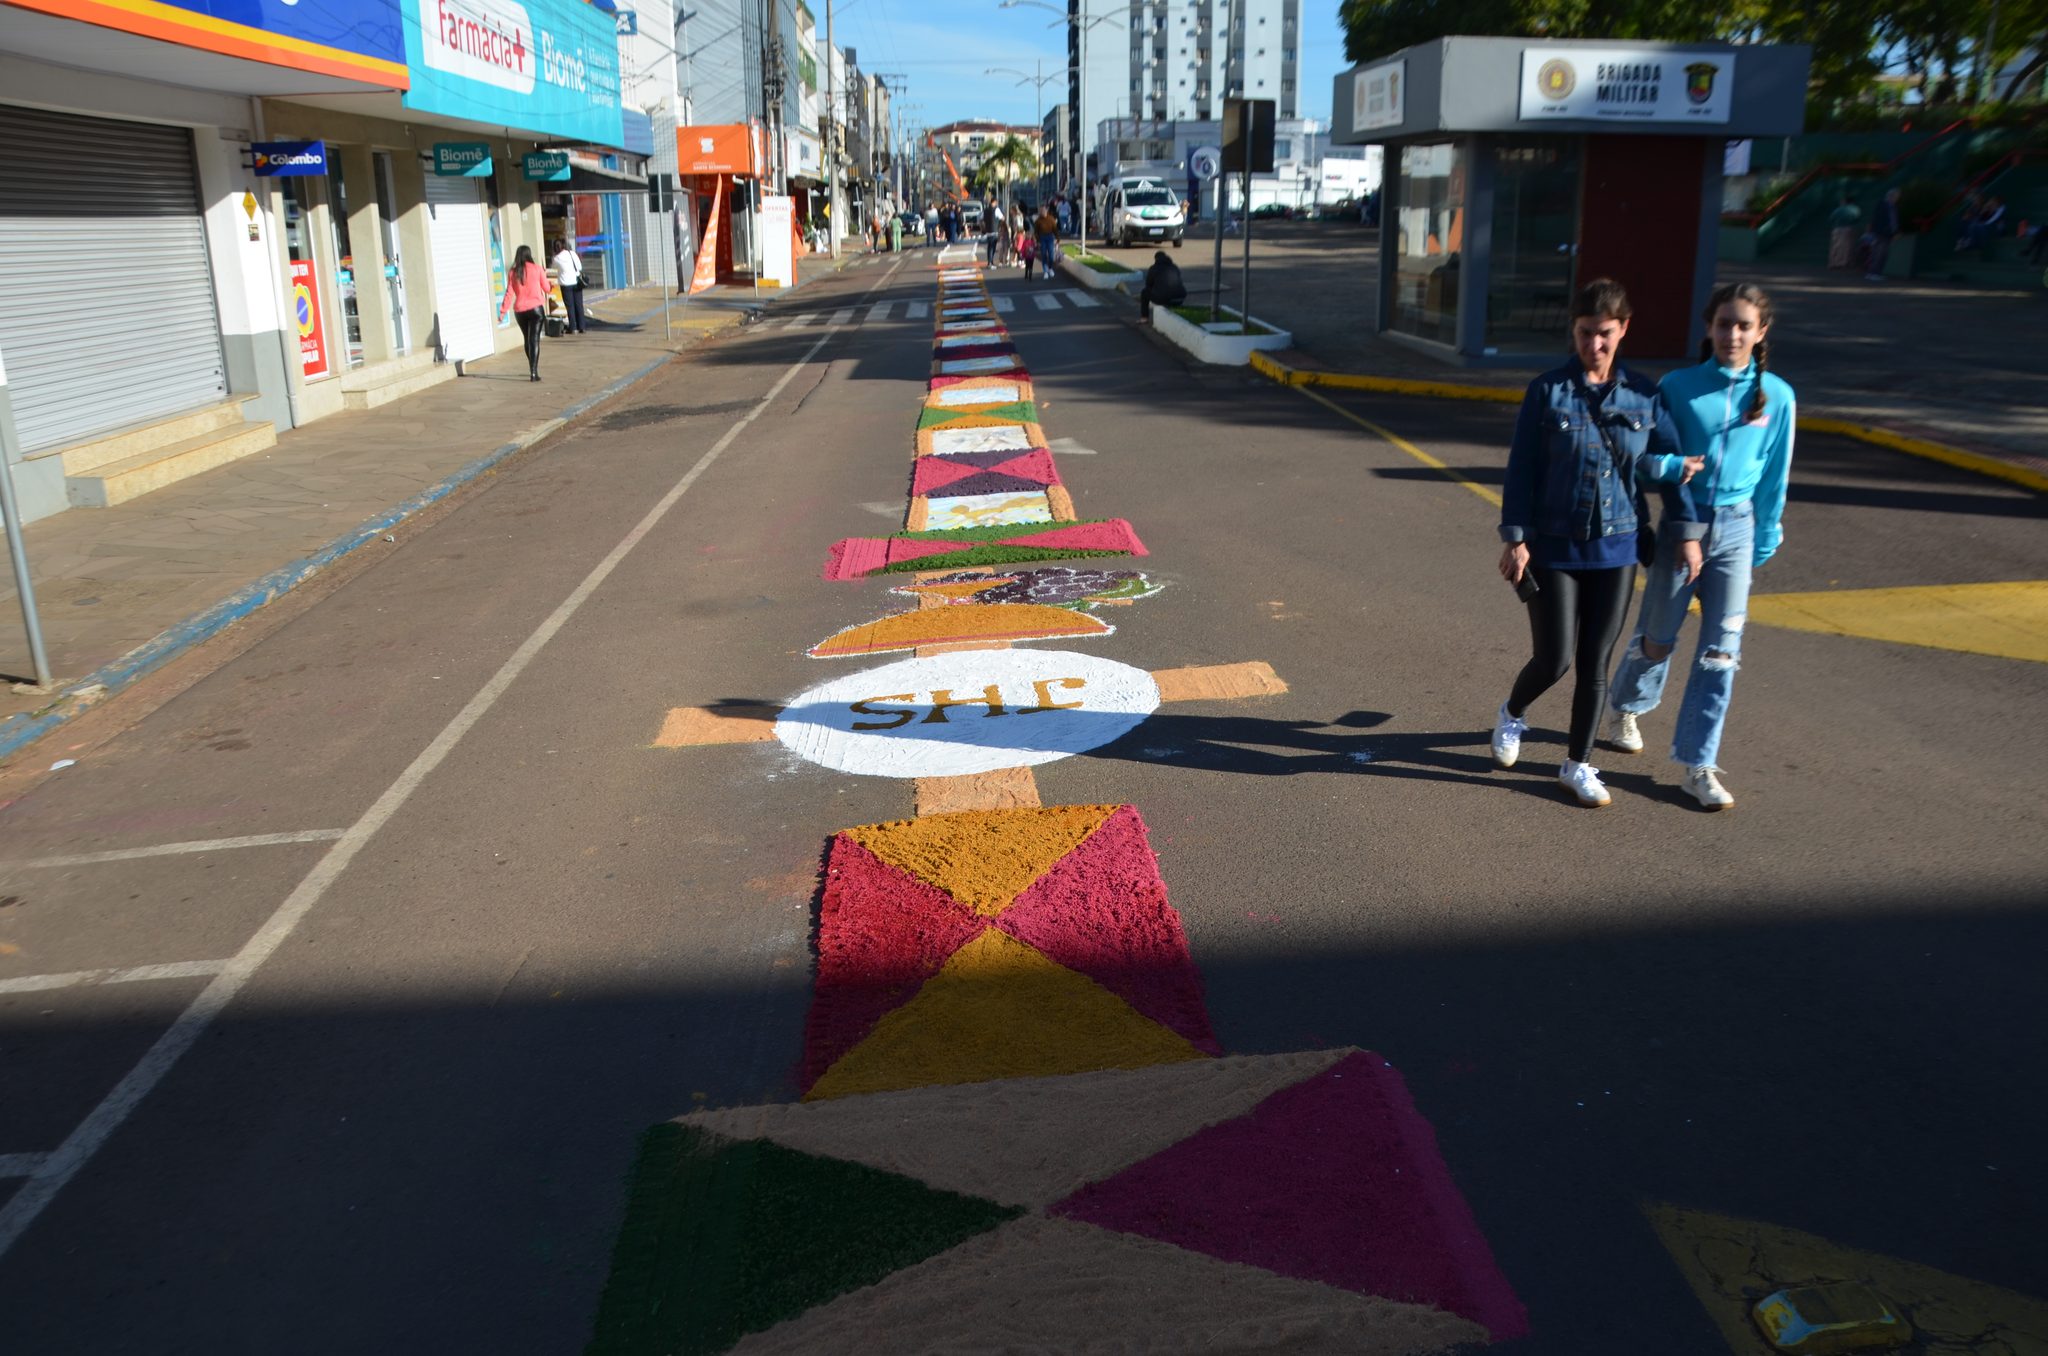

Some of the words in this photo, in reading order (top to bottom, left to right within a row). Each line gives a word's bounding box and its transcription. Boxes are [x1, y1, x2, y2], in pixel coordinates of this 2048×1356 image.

[1597, 63, 1662, 81] BRIGADA
[1596, 84, 1659, 102] MILITAR
[269, 152, 322, 165] Colombo
